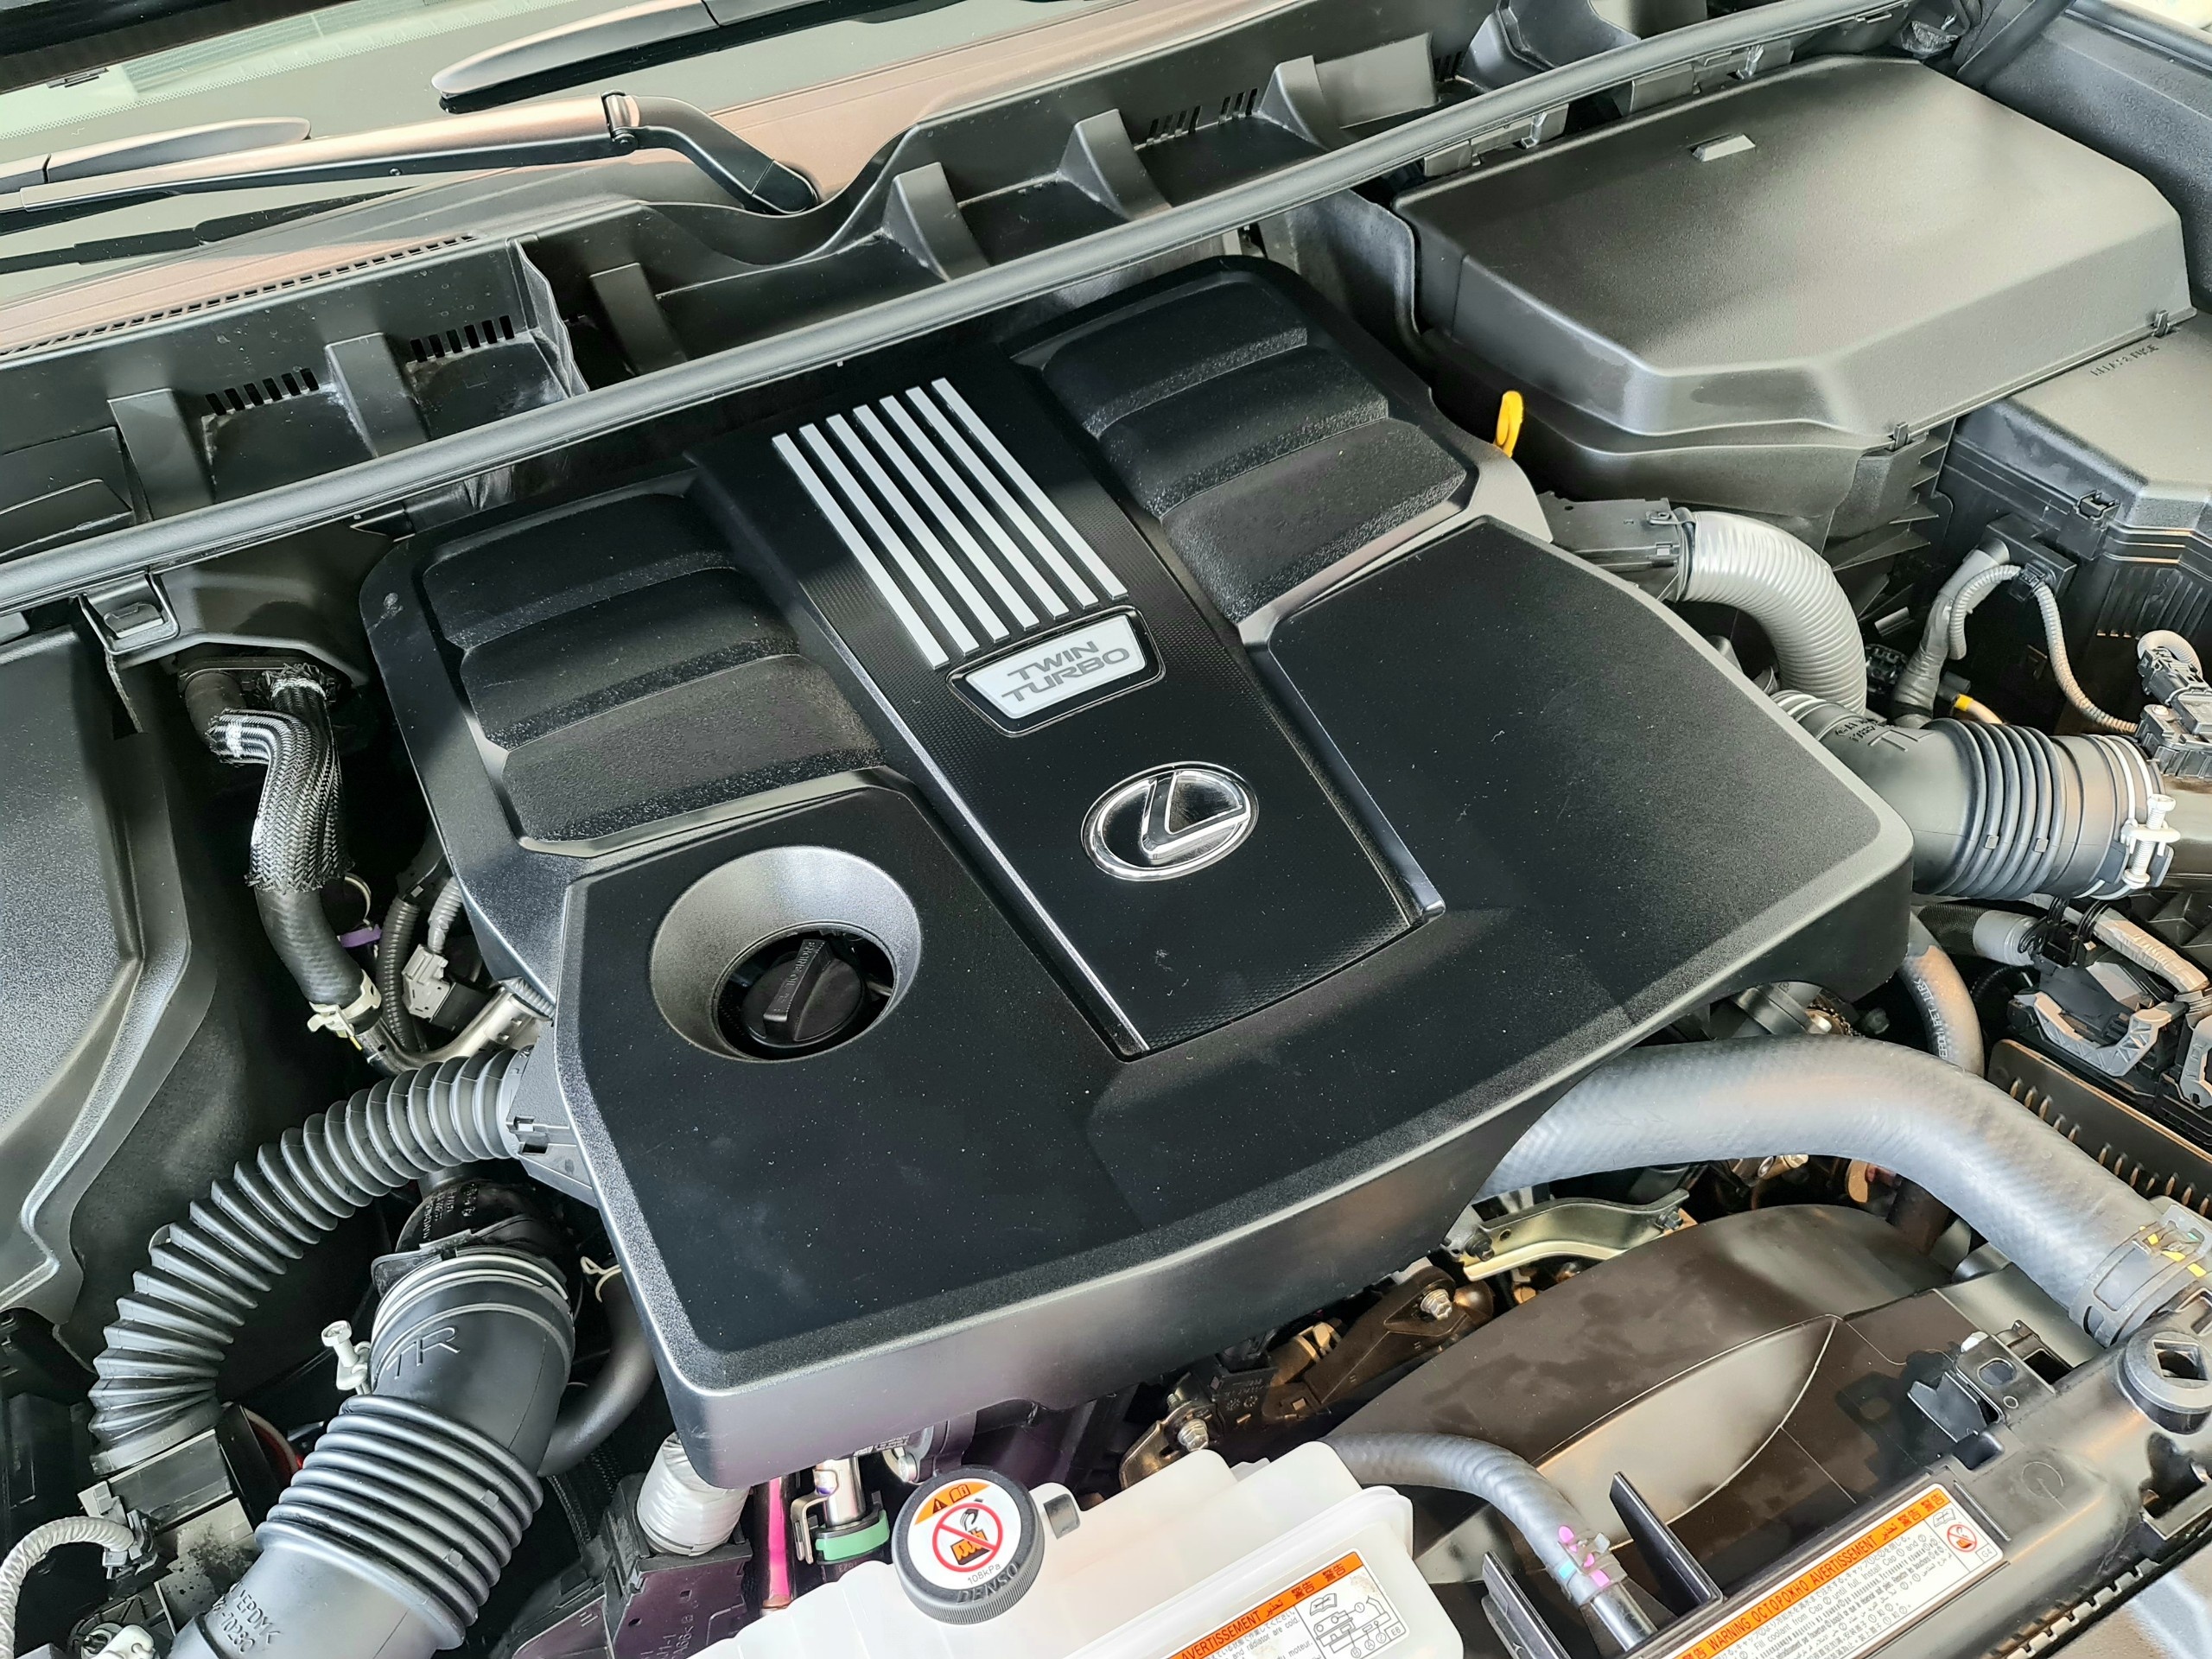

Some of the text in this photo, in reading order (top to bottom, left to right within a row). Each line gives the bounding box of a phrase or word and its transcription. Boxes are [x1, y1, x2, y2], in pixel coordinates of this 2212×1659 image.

[1001, 647, 1130, 702] TURBO
[1007, 640, 1099, 680] TWIN
[956, 1560, 1020, 1605] DENSO
[967, 1562, 1002, 1586] 108kPa
[1707, 1618, 1751, 1651] WARNING
[1808, 1534, 1878, 1586] AVERTISSEMENT
[1753, 1639, 1766, 1651] Fill
[1767, 1623, 1792, 1643] coolant
[1791, 1613, 1808, 1625] from
[1808, 1603, 1823, 1615] Cap
[1832, 1586, 1847, 1599] until
[1860, 1563, 1882, 1580] Install
[1882, 1554, 1897, 1567] Cap
[1905, 1540, 1919, 1552] and
[1181, 1611, 1262, 1659] AVERTISSEMENT
[1246, 1635, 1270, 1651] radiator
[1273, 1627, 1283, 1636] are
[1285, 1616, 1300, 1629] cold.
[1287, 1640, 1313, 1657] moteur.
